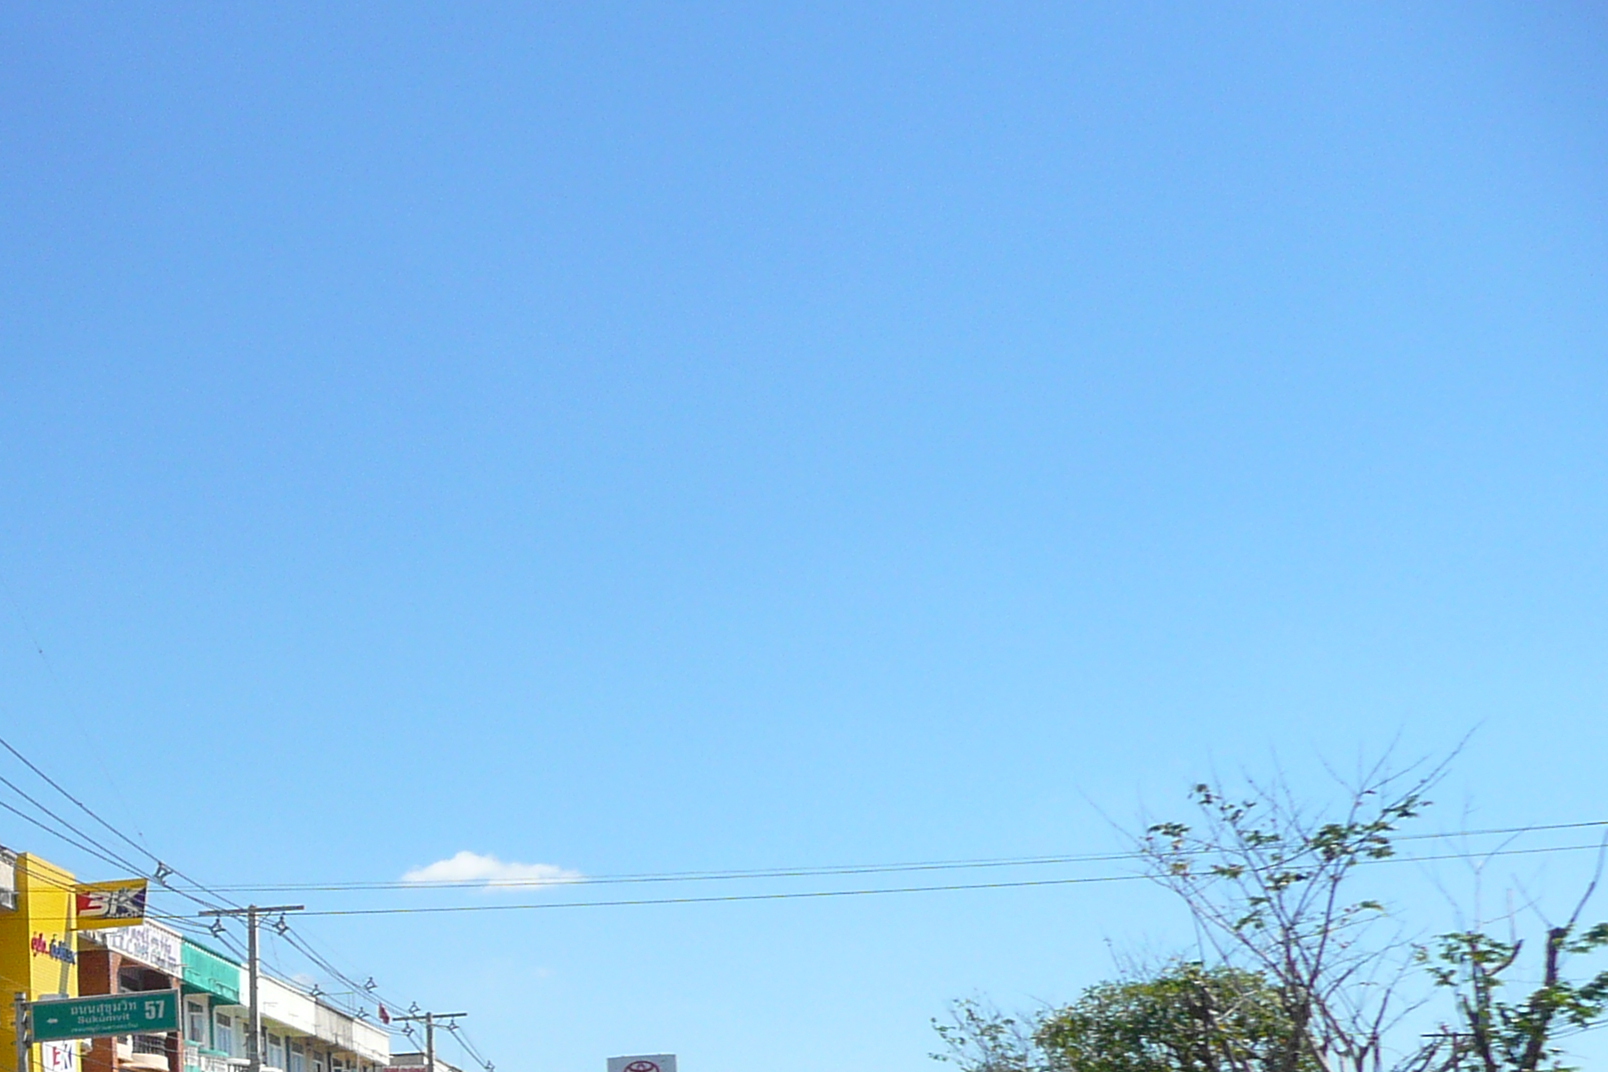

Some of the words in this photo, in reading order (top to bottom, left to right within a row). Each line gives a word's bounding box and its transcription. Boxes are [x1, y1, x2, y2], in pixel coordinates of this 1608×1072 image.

[70, 1000, 138, 1017] ถนนสุขุมวิท
[144, 1000, 166, 1021] 57
